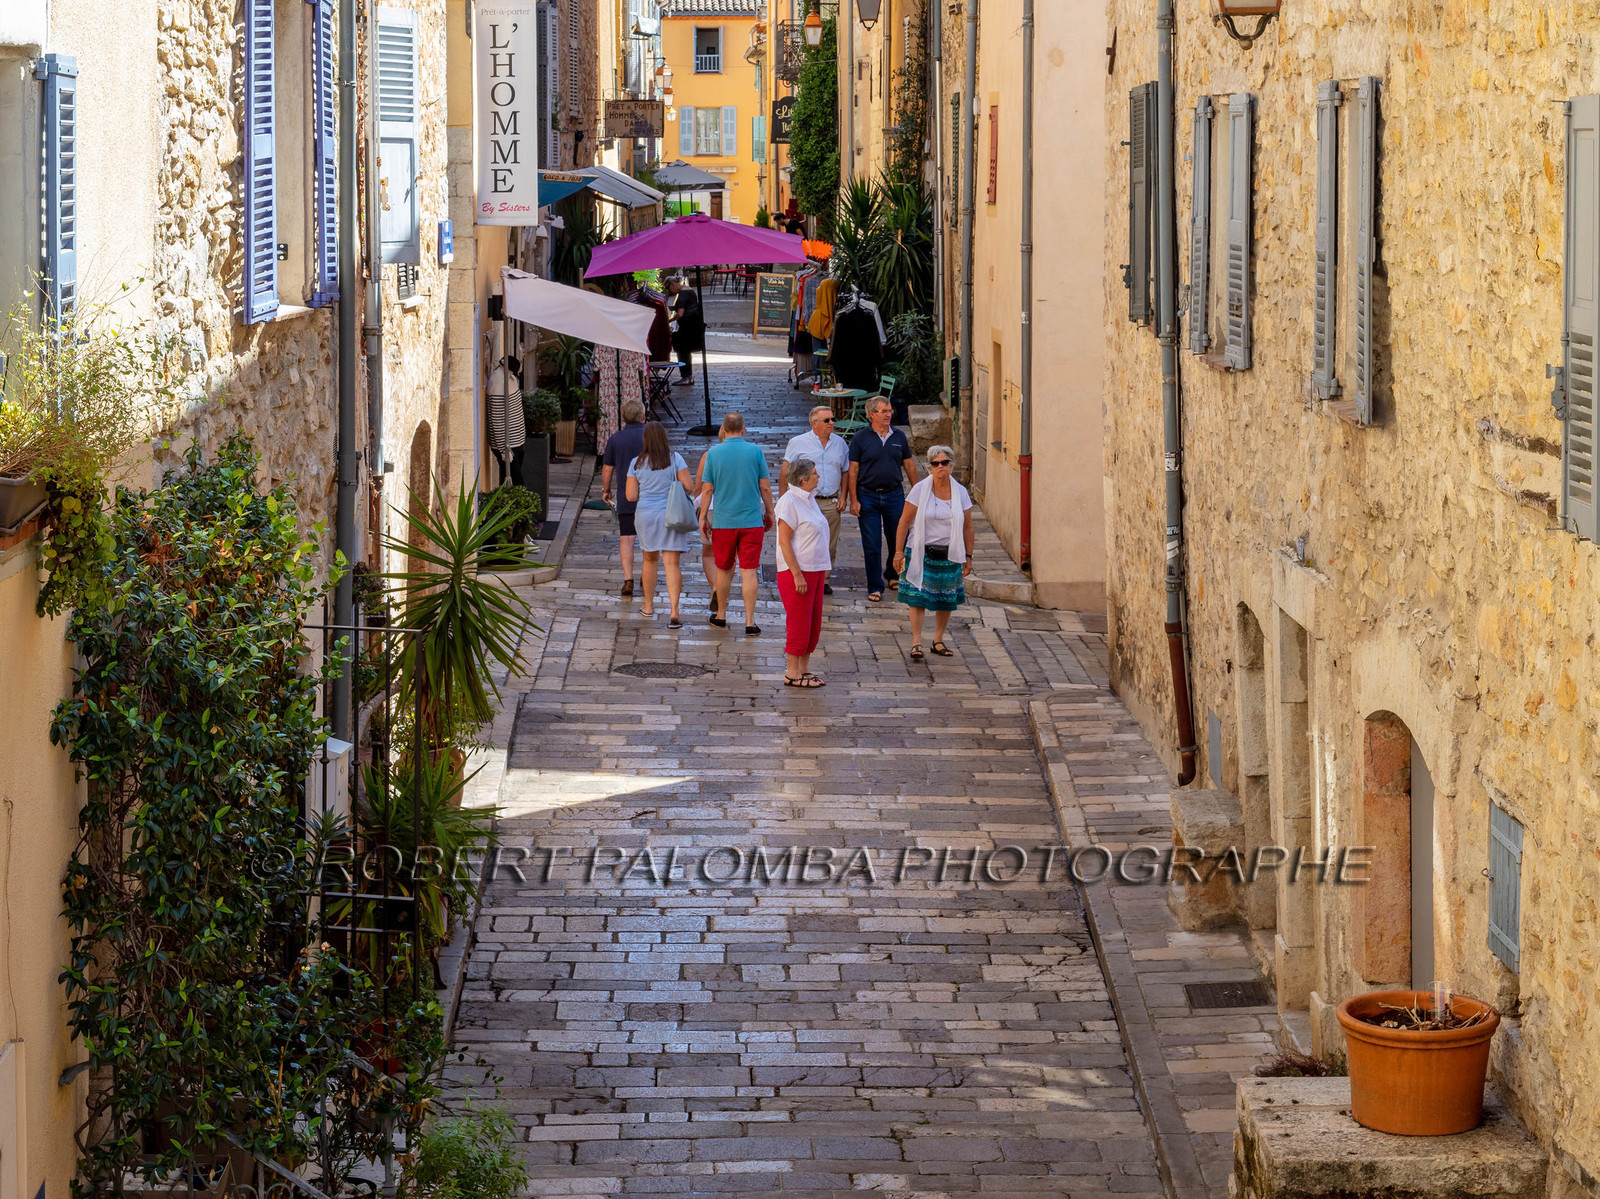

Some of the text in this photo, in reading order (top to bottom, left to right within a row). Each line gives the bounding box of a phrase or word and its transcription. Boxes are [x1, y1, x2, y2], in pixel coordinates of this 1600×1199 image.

[634, 103, 660, 111] PORTER
[481, 201, 531, 214] By Sisters
